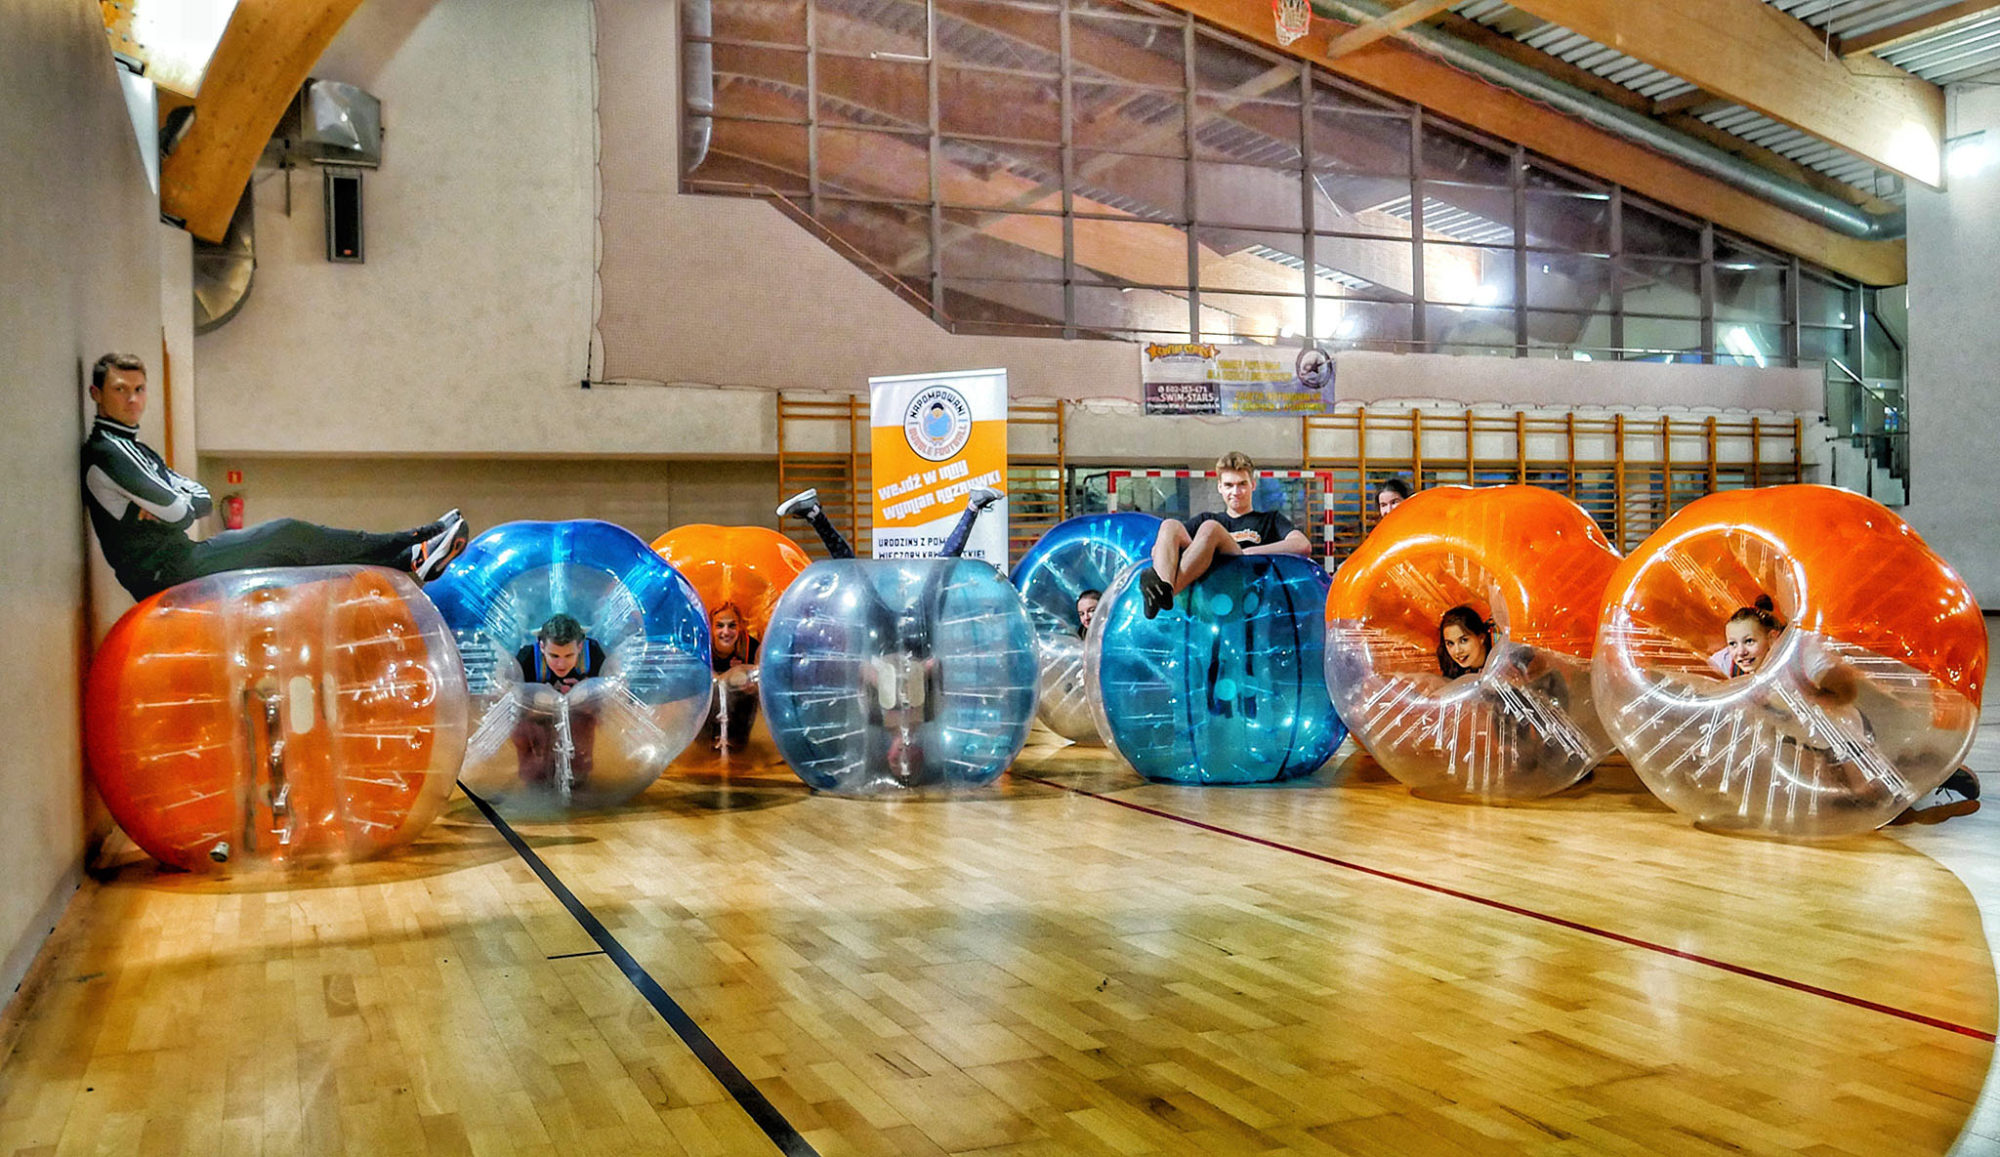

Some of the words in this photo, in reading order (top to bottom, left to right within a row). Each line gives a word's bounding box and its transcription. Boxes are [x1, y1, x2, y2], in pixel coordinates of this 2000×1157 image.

[910, 391, 966, 418] NAPOMPOWANI
[909, 427, 933, 456] BUBBLE
[934, 424, 967, 456] FOOTBALL
[878, 538, 919, 547] URODZINY
[920, 538, 925, 547] Z
